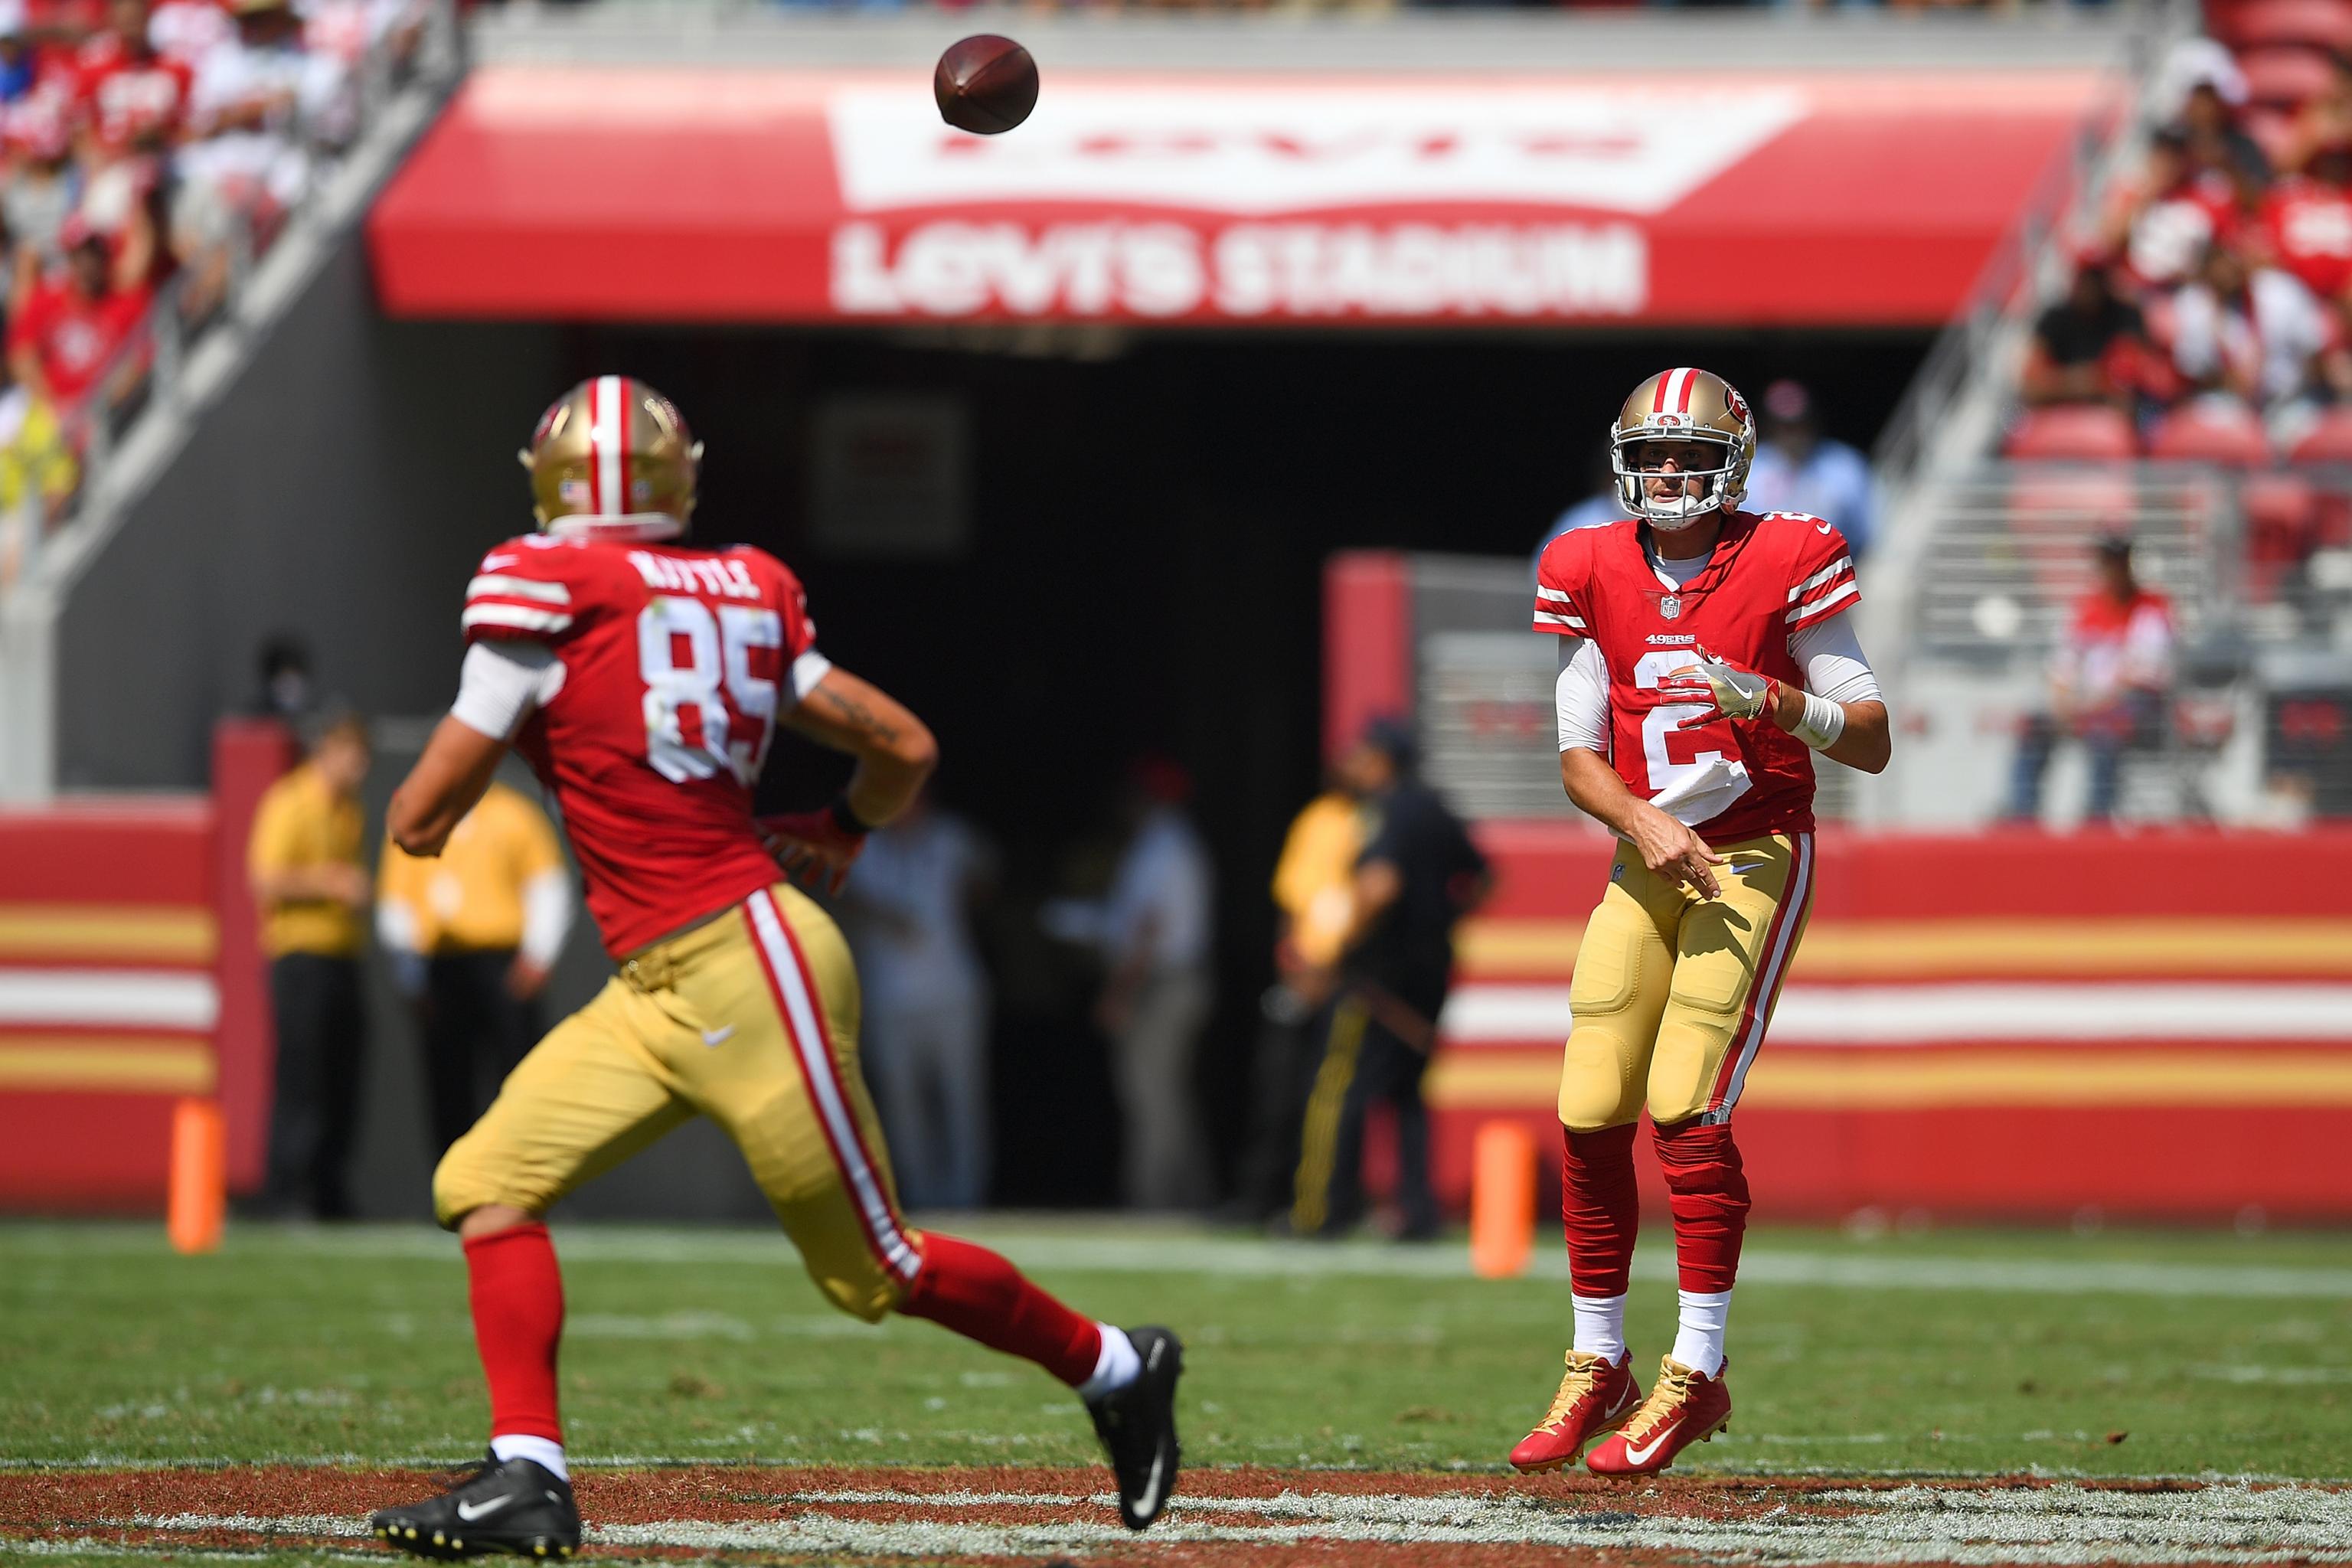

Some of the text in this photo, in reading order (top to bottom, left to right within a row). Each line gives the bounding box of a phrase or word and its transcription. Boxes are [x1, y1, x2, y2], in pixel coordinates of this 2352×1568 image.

[1217, 224, 1643, 314] STADIUM
[637, 596, 782, 789] 85
[1645, 634, 1696, 645] 49ERS
[1633, 649, 1723, 791] 2
